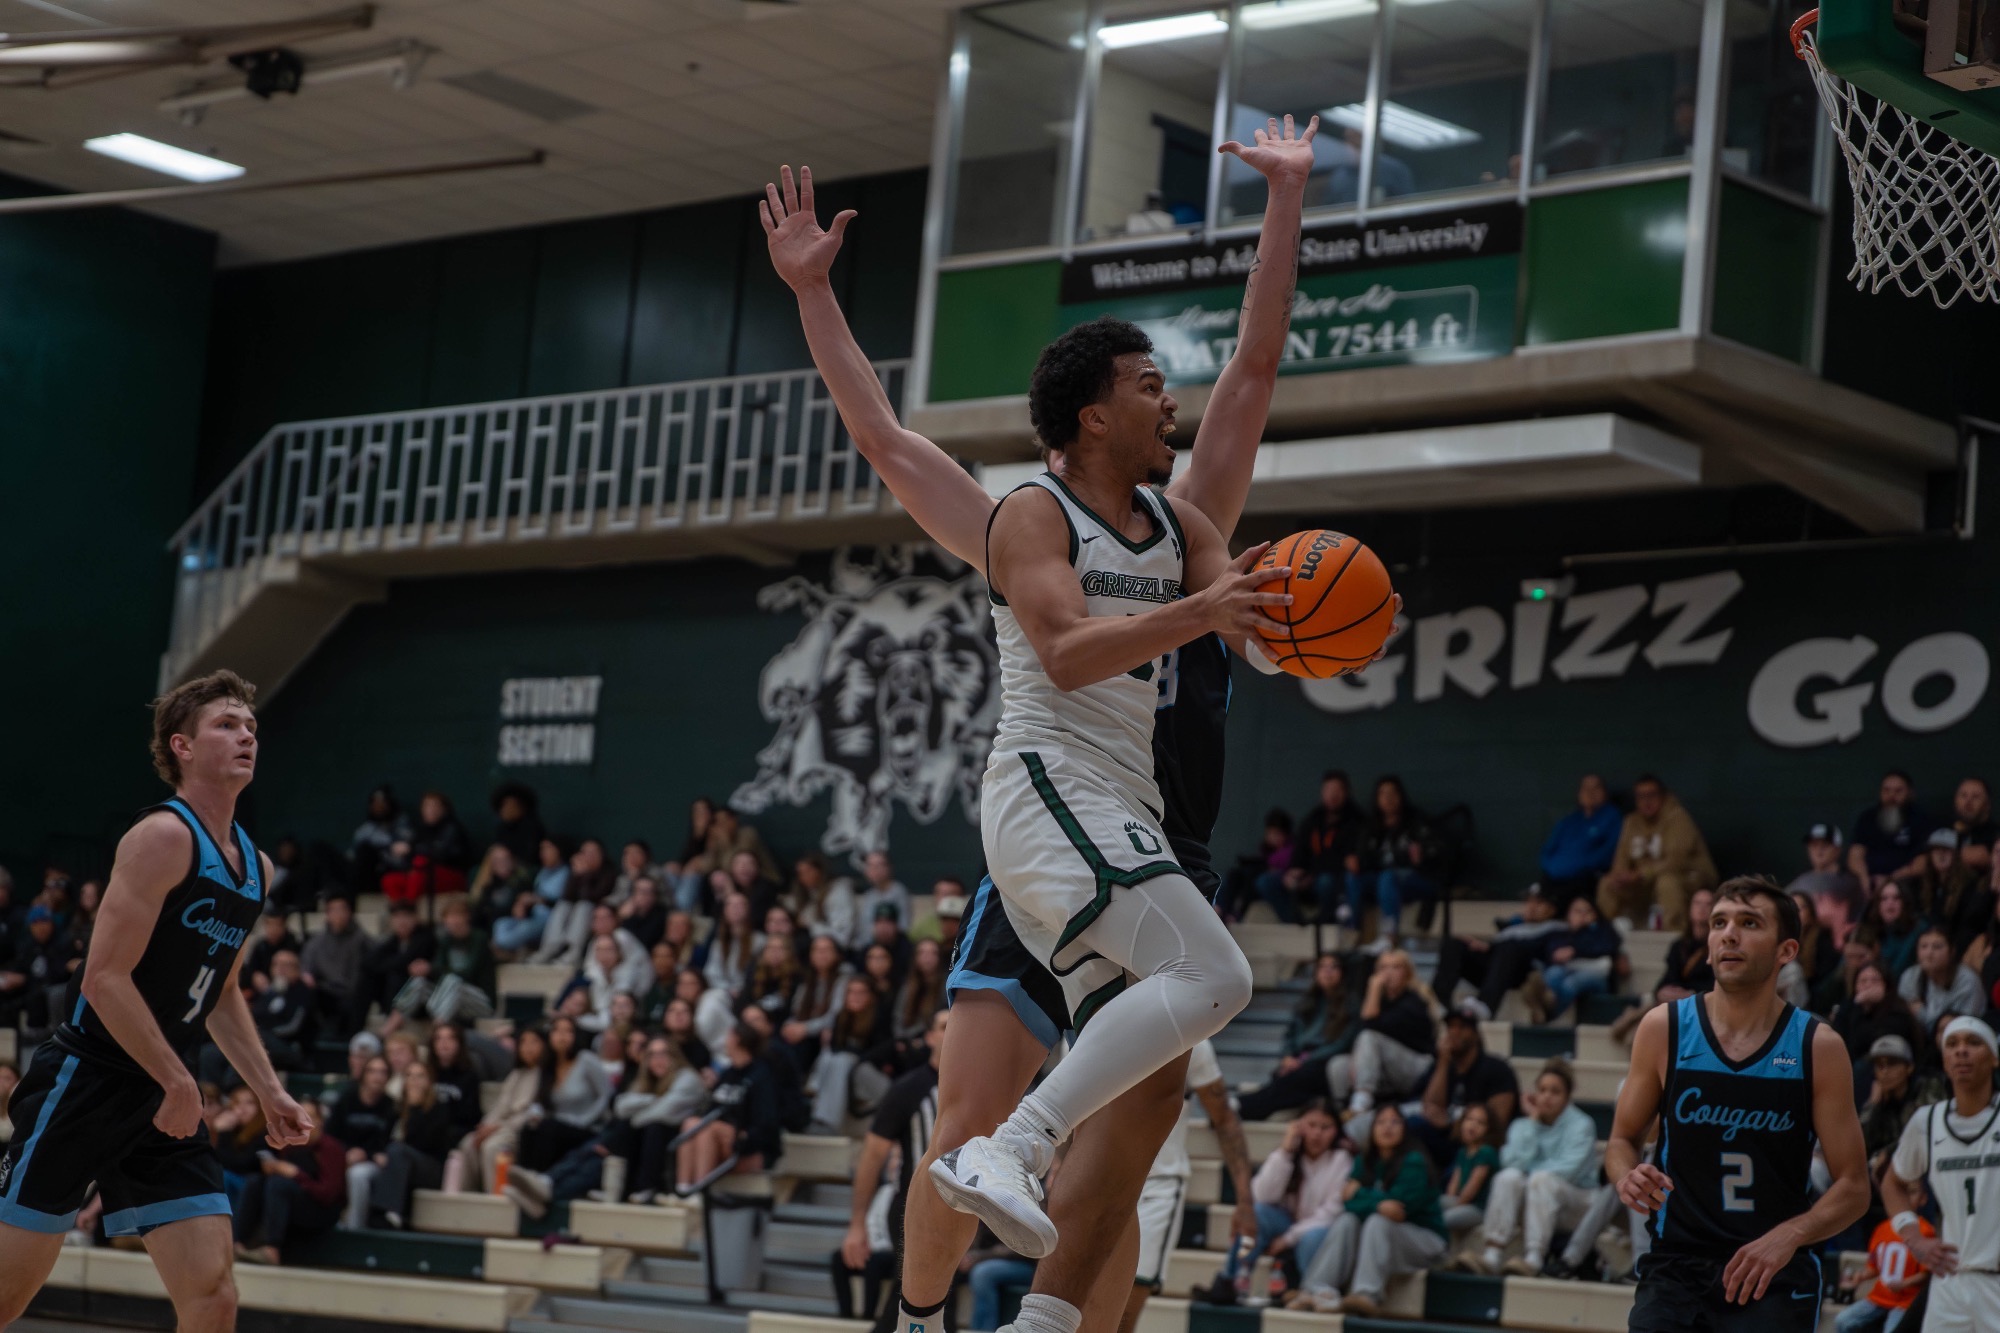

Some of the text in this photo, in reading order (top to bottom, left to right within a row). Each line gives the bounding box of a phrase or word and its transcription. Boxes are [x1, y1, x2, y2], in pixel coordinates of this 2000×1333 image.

[1092, 258, 1189, 290] Welcome
[1190, 255, 1218, 279] to
[1300, 237, 1361, 266] State
[1364, 218, 1488, 258] University
[1327, 317, 1418, 357] 7544
[1432, 312, 1462, 346] ft
[1081, 570, 1181, 604] GRIZZLIE
[1301, 569, 1744, 714] GRIZZ
[1747, 630, 1990, 748] GO
[500, 675, 603, 719] STUDENT
[498, 723, 595, 767] SECTION
[181, 897, 248, 956] Cougar
[181, 963, 216, 1024] 4
[1675, 1086, 1795, 1142] Cougars
[1720, 1151, 1755, 1212] 2
[1965, 1177, 1976, 1215] 1
